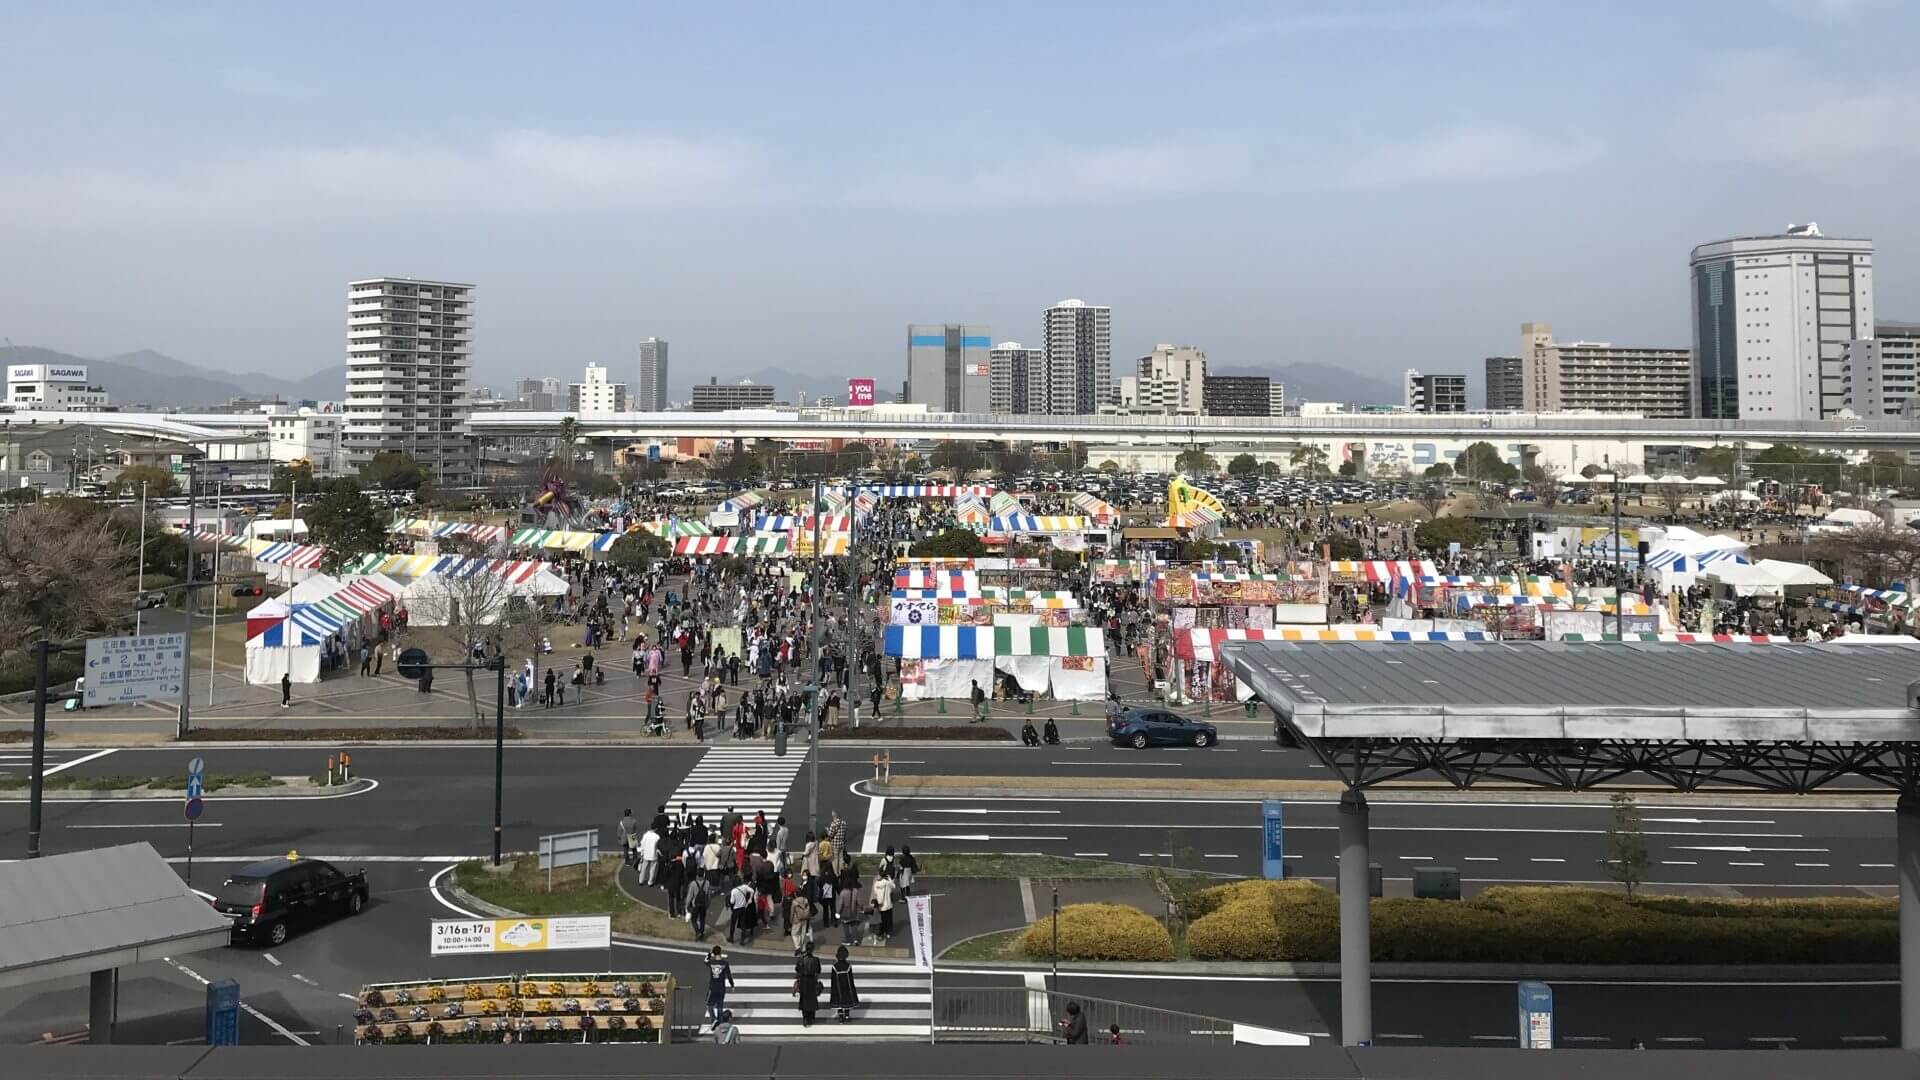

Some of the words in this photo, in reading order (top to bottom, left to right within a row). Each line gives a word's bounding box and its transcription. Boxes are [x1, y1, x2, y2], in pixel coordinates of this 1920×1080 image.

[14, 369, 33, 377] SAGAWA
[50, 369, 84, 377] SAGAWA
[855, 385, 872, 395] you
[1374, 443, 1405, 452] ホーム
[1371, 453, 1408, 463] センター
